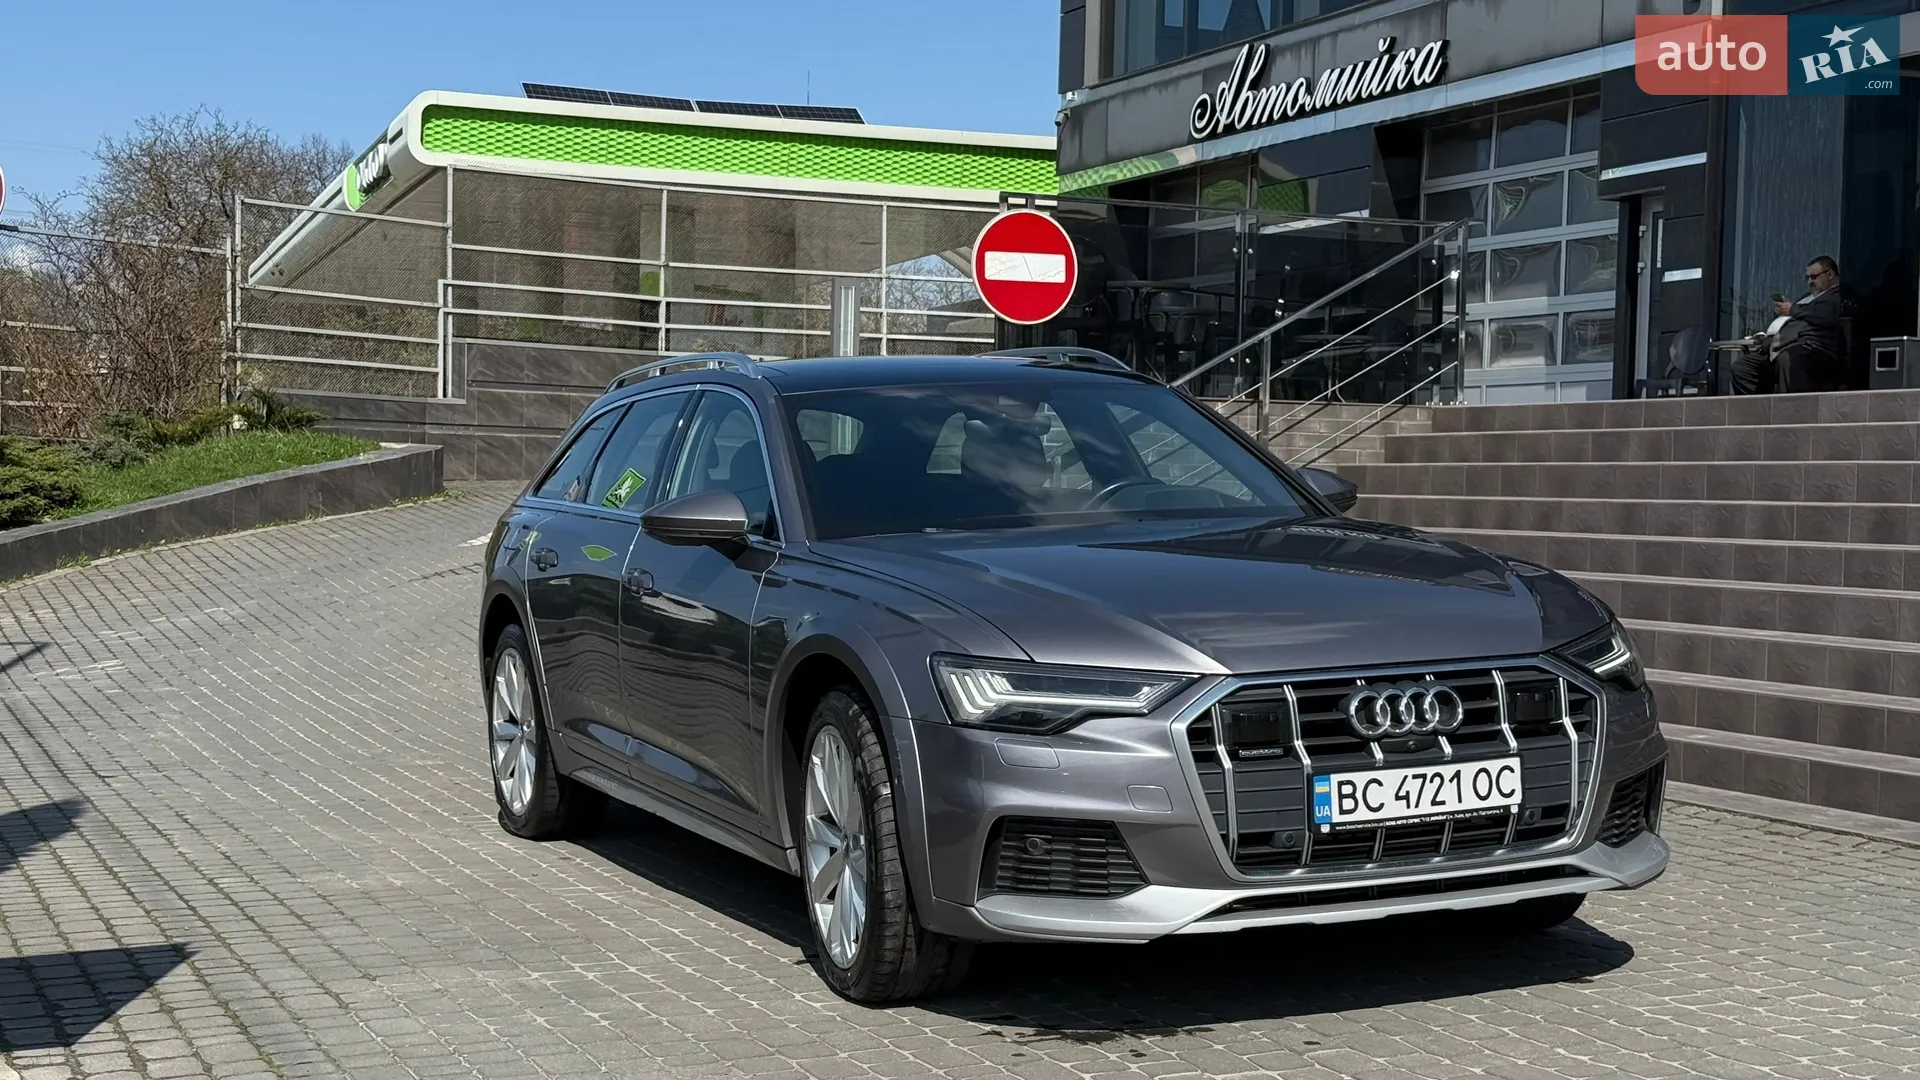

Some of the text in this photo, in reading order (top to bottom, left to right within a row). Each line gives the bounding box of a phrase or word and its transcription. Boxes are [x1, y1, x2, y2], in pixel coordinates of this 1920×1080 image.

[1190, 37, 1444, 139] Автомийка
[1394, 769, 1463, 809] 4721
[1315, 805, 1331, 817] UA
